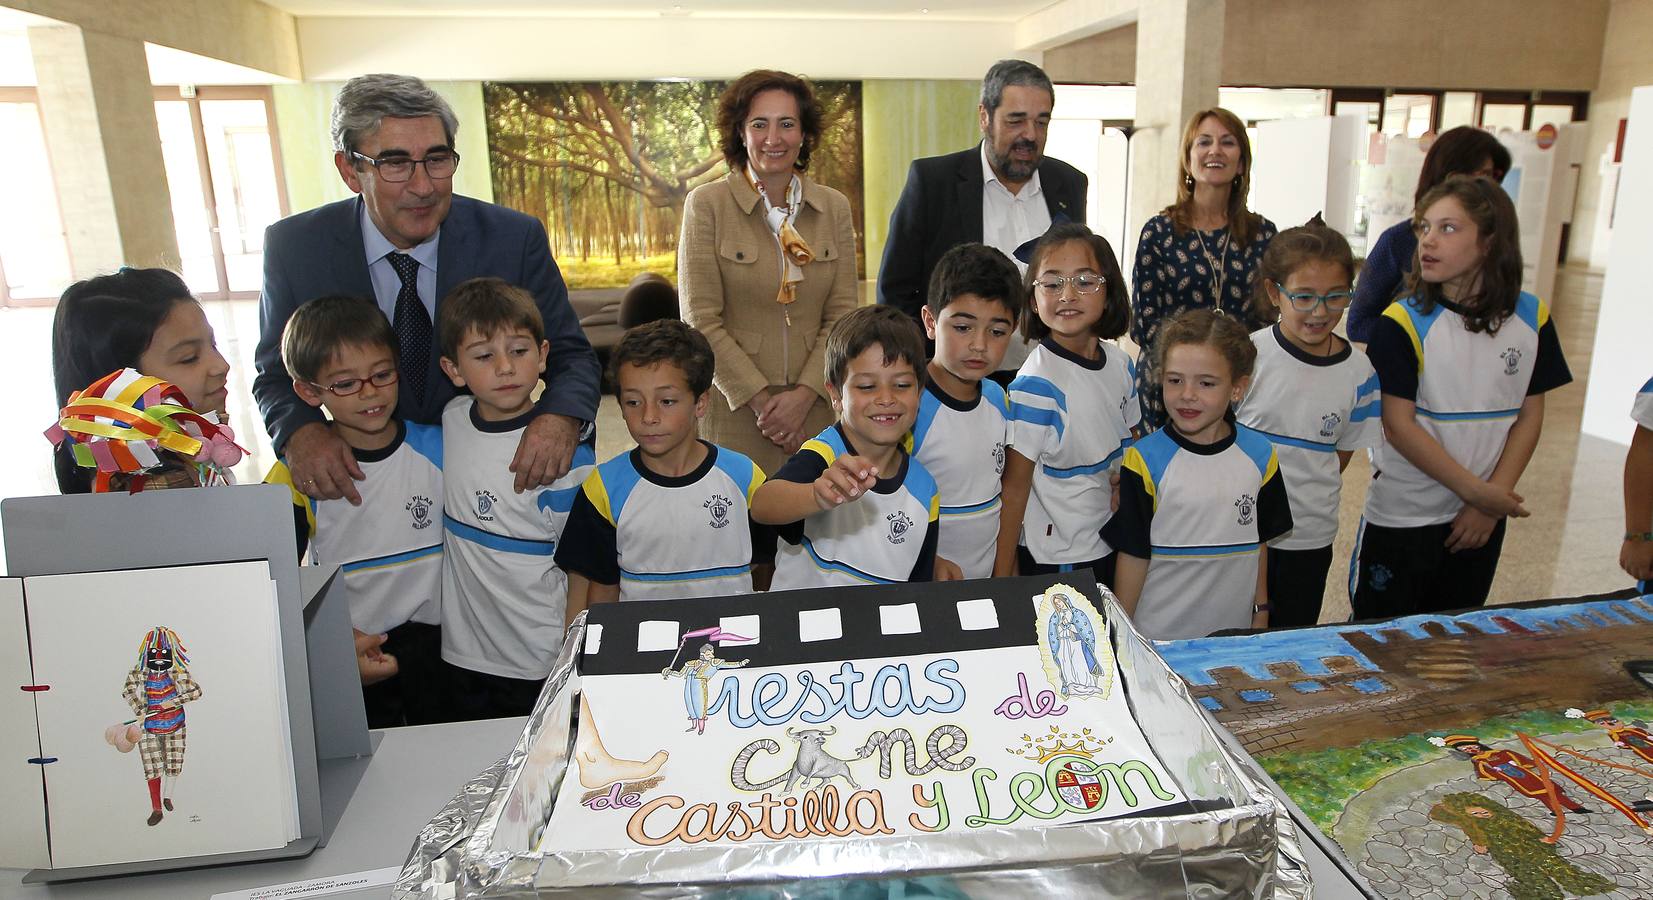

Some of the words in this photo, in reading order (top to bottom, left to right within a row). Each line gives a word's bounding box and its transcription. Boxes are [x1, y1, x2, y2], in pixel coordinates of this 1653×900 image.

[405, 502, 413, 511] EL
[412, 495, 433, 506] PILAR
[703, 500, 711, 508] EL
[711, 494, 733, 507] PILAR
[994, 672, 1068, 720] de
[582, 782, 642, 811] de
[626, 784, 895, 847] Castilla
[908, 780, 951, 832] y
